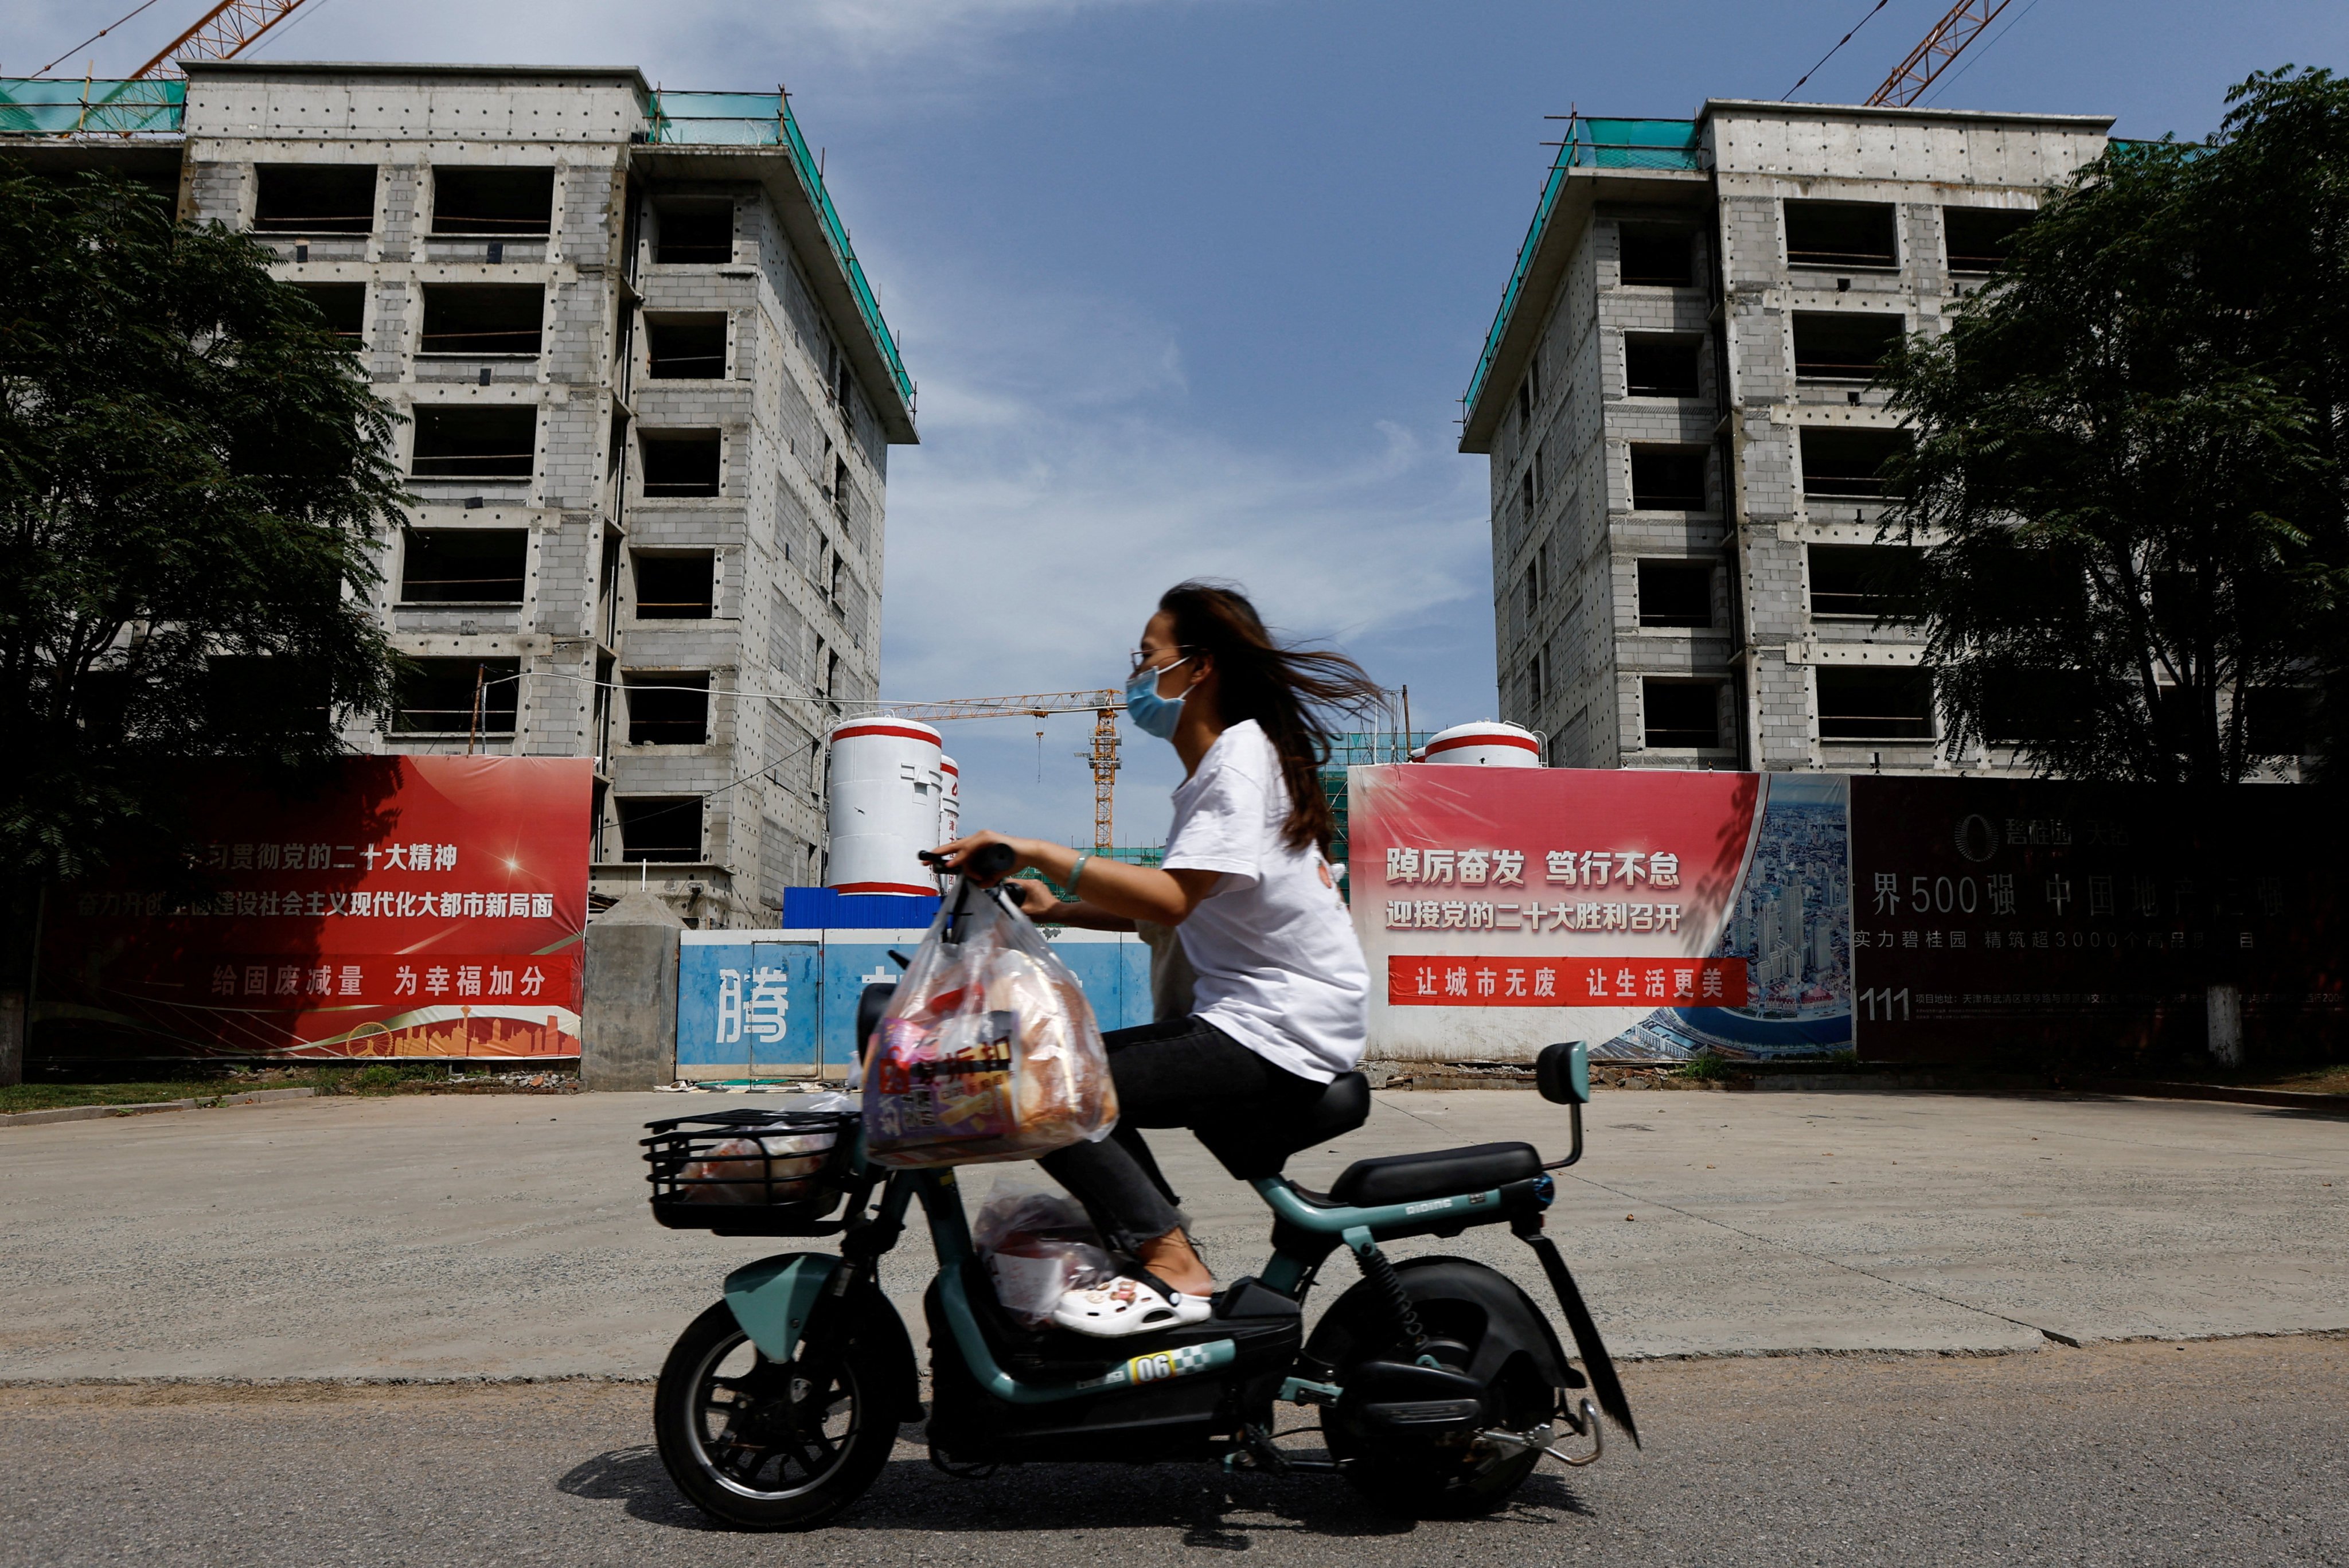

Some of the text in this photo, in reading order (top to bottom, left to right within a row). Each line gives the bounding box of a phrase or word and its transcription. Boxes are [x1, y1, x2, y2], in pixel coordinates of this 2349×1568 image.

[181, 843, 458, 873] 习贯彻党的二十大精神
[1386, 848, 1680, 889] 踔厉奋发 笃行不怠
[1386, 900, 1681, 932] 迎接党的二十大胜利召开
[1854, 930, 1967, 949] 实力碧桂园
[212, 964, 546, 997] 给固废减量 为幸福加分
[1415, 966, 1724, 999] 让城市无废 让生活更美
[1136, 1354, 1171, 1382] 06
